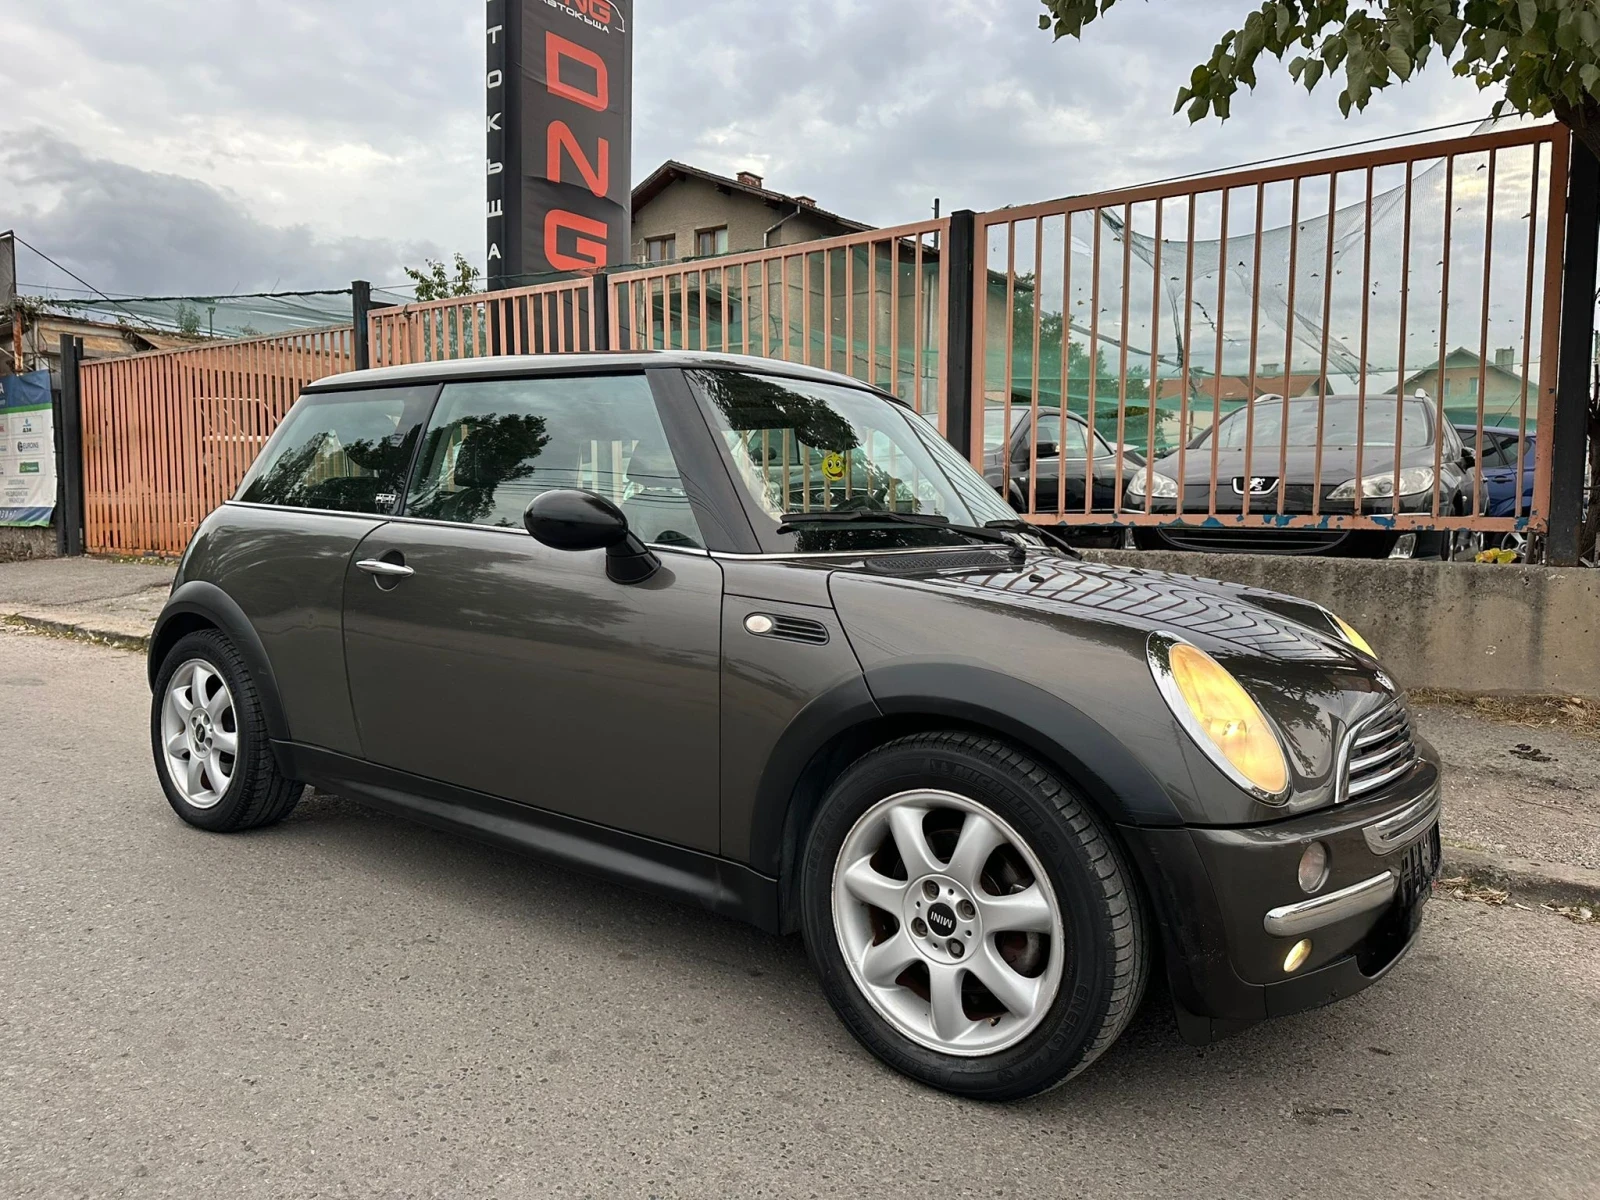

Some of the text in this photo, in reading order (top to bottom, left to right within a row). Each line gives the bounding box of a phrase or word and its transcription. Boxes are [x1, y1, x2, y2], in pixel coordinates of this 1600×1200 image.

[486, 0, 504, 261] ТОКЪЩА
[543, 30, 610, 273] DNG
[930, 911, 953, 929] MINI
